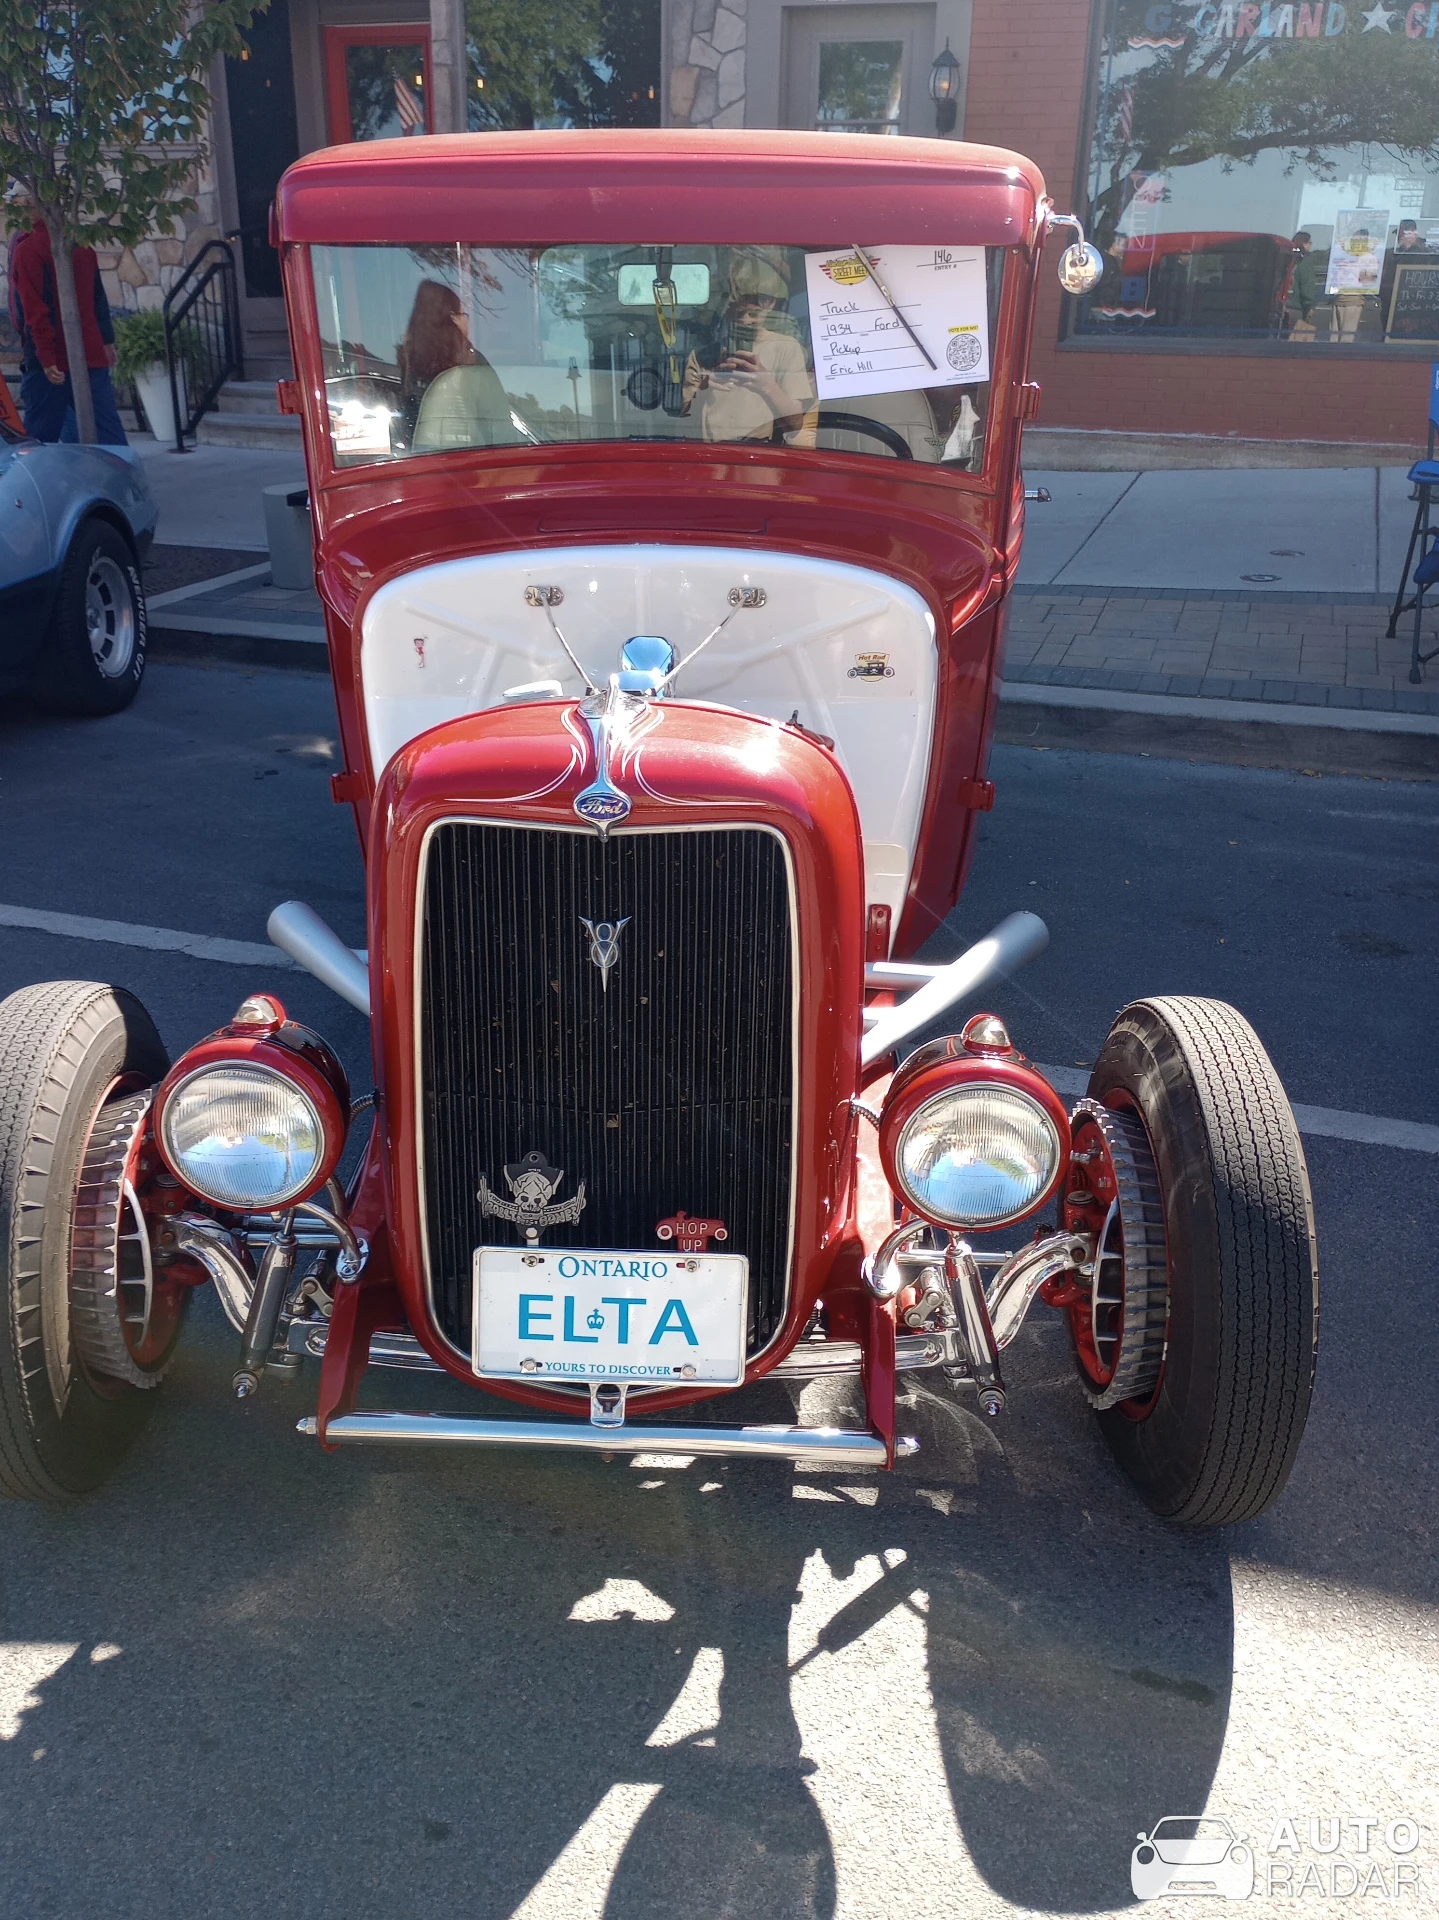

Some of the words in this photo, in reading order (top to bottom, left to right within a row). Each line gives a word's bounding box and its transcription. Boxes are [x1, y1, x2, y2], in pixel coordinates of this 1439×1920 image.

[1194, 2, 1347, 39] GARLAND
[934, 248, 952, 265] 146
[832, 266, 852, 278] STREET
[820, 301, 860, 314] Truck
[826, 323, 853, 336] 1934
[874, 316, 900, 331] Ford
[829, 341, 861, 356] Pickup
[830, 363, 854, 375] Eric
[857, 360, 873, 371] Hill
[127, 565, 146, 648] AVENGER
[580, 797, 624, 815] Ford
[676, 1222, 709, 1235] HOP
[682, 1239, 703, 1251] UP
[518, 1293, 699, 1346] ELTA
[544, 1361, 586, 1372] YOURS
[589, 1363, 604, 1373] TO
[609, 1364, 671, 1375] DISCOVER
